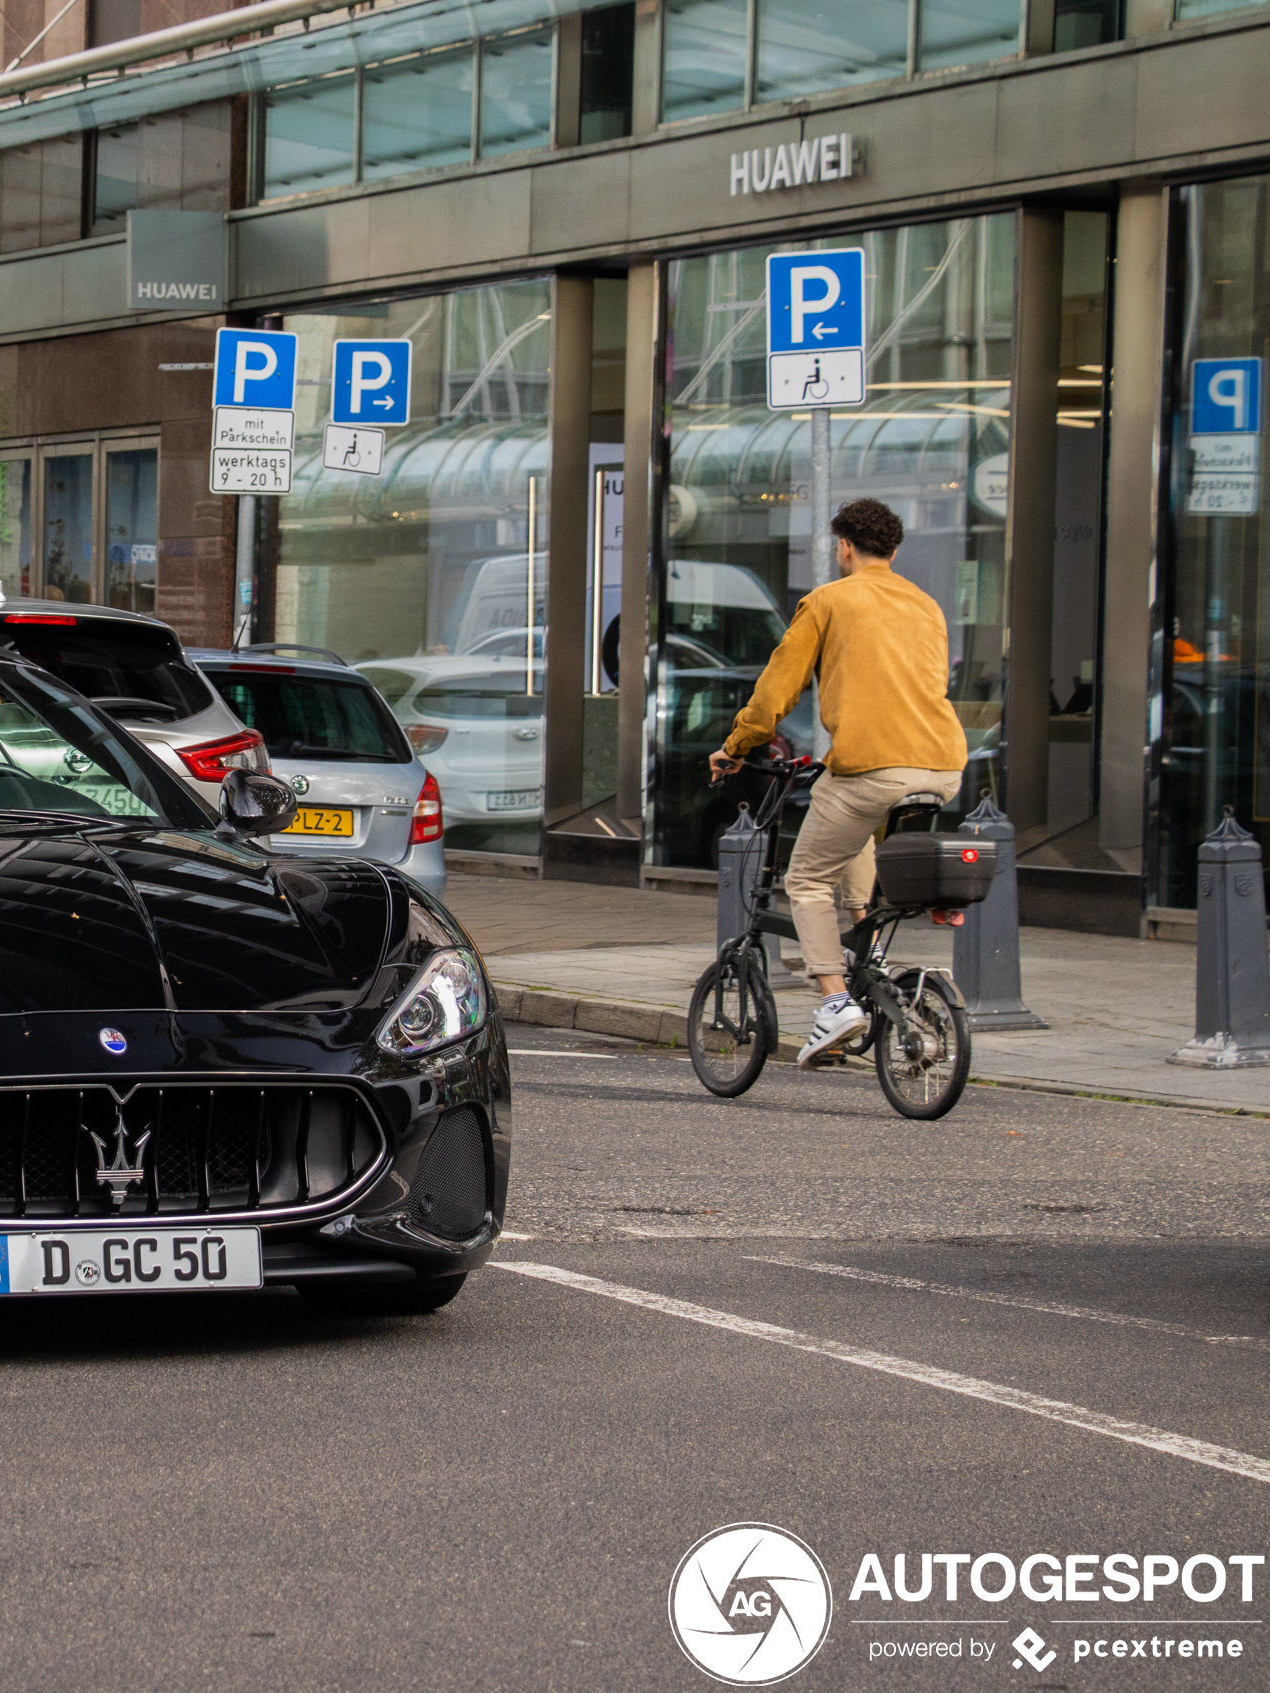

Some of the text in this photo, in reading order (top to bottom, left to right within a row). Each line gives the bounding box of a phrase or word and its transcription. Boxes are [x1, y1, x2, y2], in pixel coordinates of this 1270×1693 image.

[731, 132, 852, 196] HUAWEI
[137, 282, 217, 300] HUAWEI
[790, 265, 841, 343] P
[233, 340, 278, 403] P
[349, 350, 392, 414] P
[220, 430, 287, 446] Parkschein
[244, 418, 264, 430] mit
[218, 454, 287, 471] werktags
[221, 472, 230, 485] 9
[250, 473, 268, 487] 20
[273, 470, 282, 487] h
[40, 1239, 70, 1285] D
[102, 1237, 161, 1283] GC
[173, 1236, 228, 1281] 50
